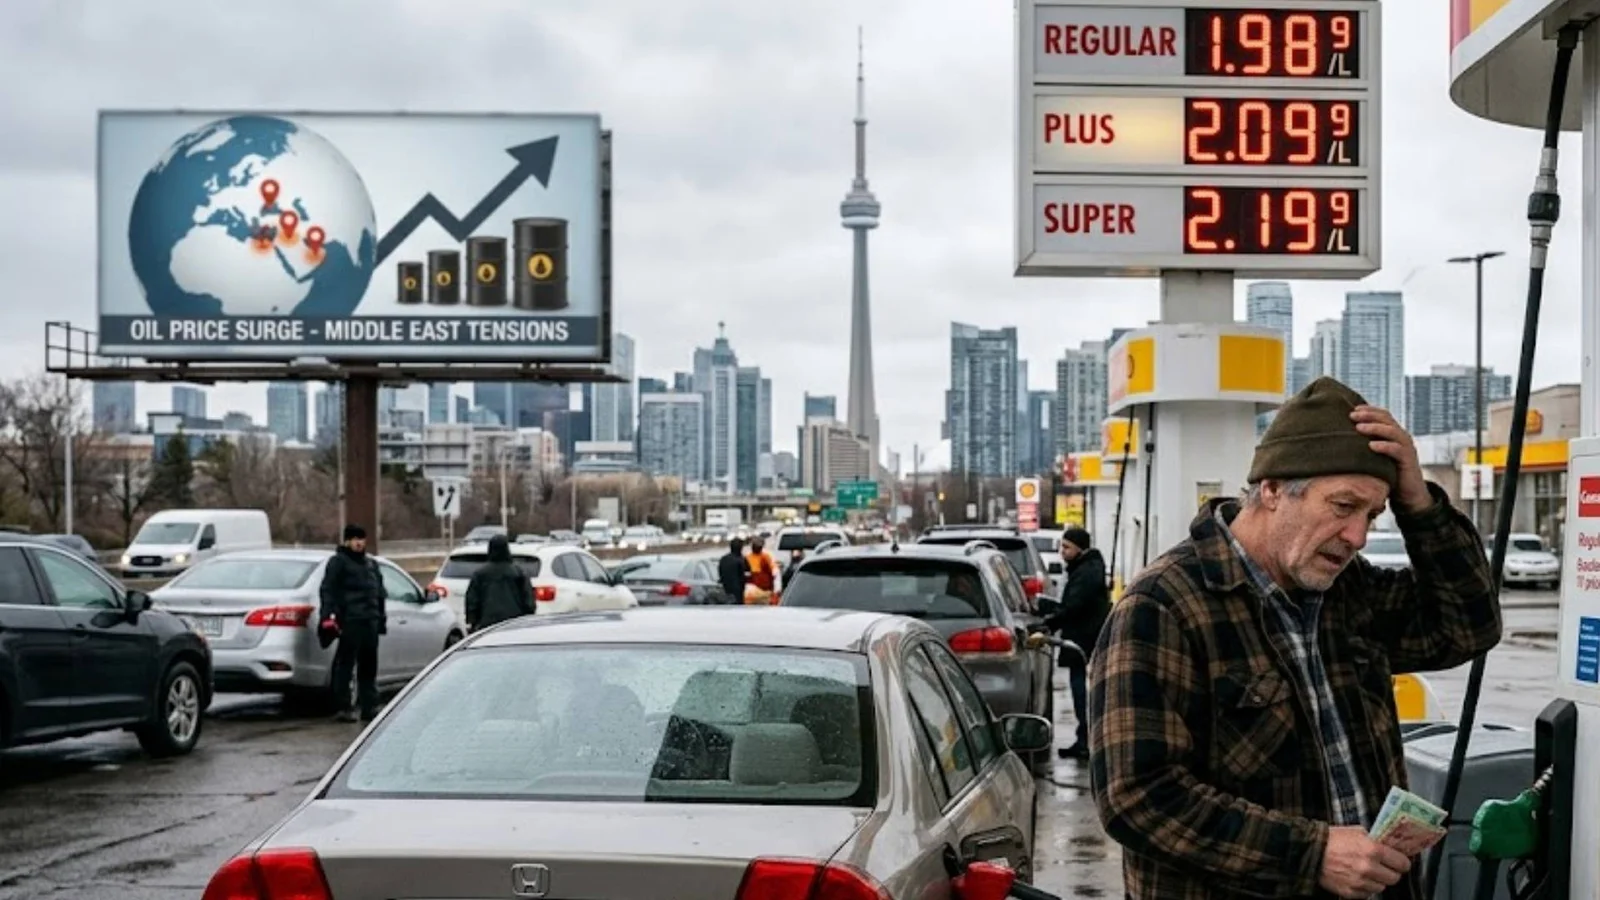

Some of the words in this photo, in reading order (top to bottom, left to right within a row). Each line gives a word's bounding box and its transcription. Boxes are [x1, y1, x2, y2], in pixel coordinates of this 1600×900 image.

[1045, 25, 1176, 56] REGULAR
[1212, 14, 1317, 75] 1.98
[1331, 16, 1350, 48] 9
[1328, 53, 1351, 75] /L
[1044, 113, 1115, 144] PLUS
[1188, 102, 1317, 162] 2.09
[1331, 104, 1350, 137] 9
[1328, 141, 1351, 163] /L
[1044, 203, 1135, 234] SUPER
[1188, 190, 1317, 250] 2.19
[1331, 191, 1350, 224] 9
[1328, 229, 1351, 251] /L
[130, 319, 163, 341] OIL
[169, 319, 229, 341] PRICE
[235, 319, 303, 341] SURGE
[325, 320, 403, 341] MIDDLE
[409, 320, 460, 341] EAST
[466, 320, 569, 341] TENSIONS
